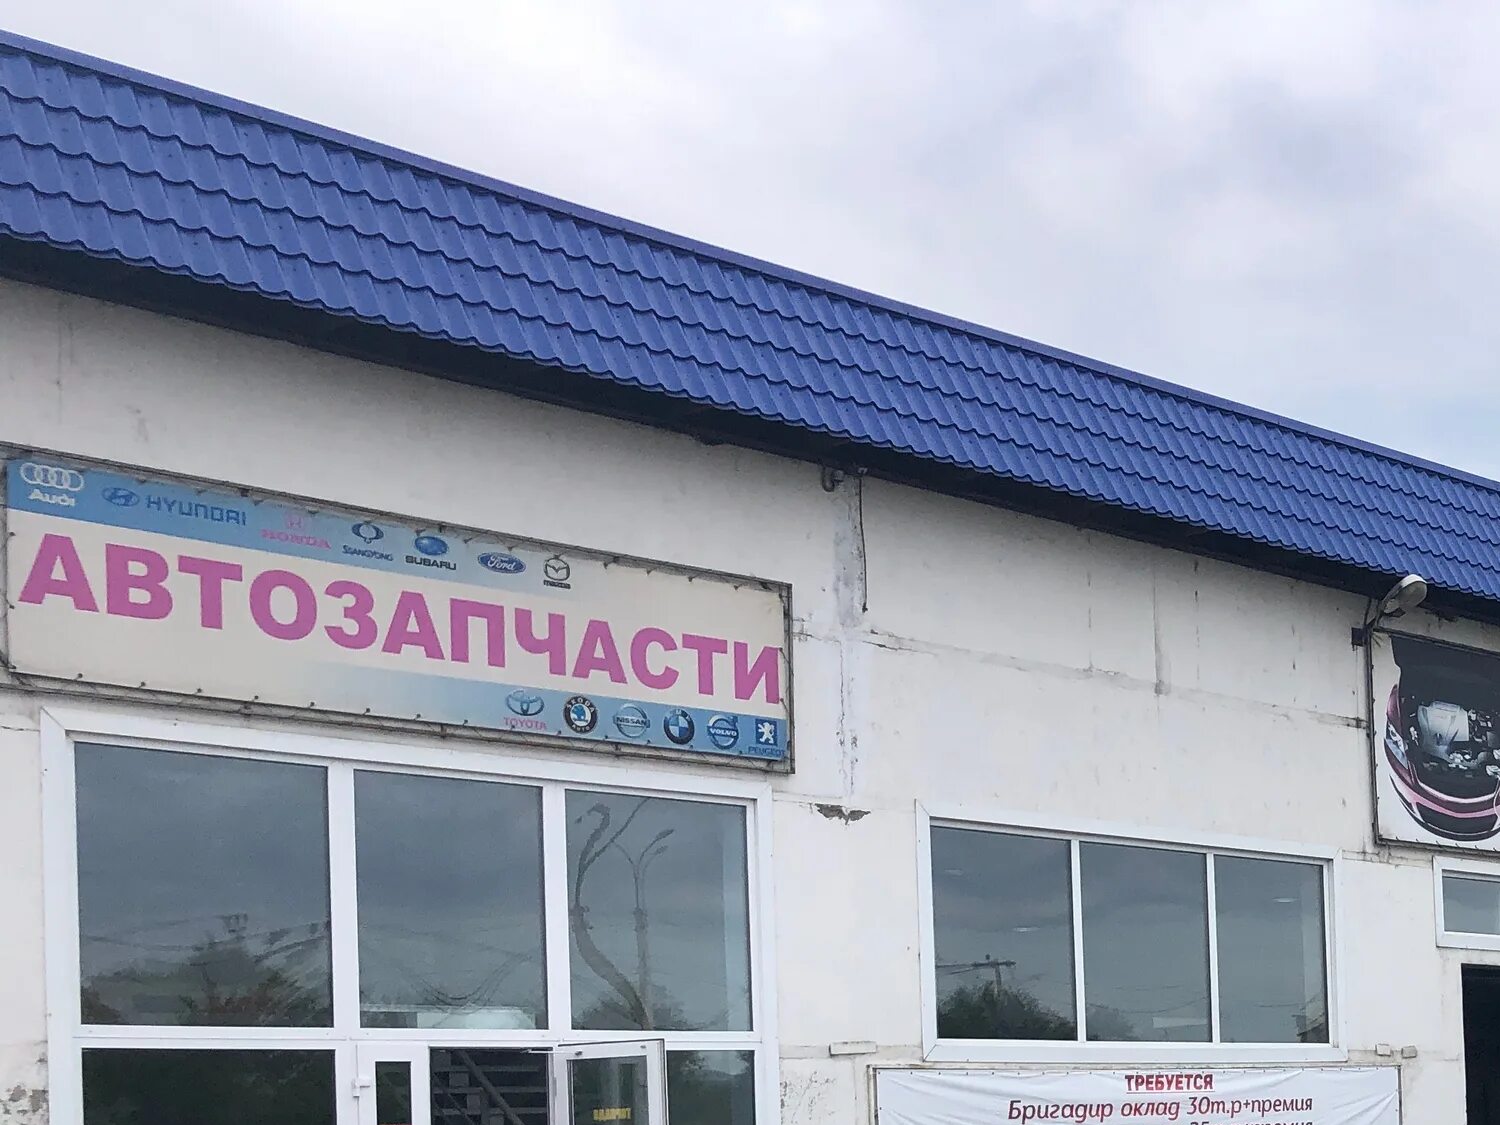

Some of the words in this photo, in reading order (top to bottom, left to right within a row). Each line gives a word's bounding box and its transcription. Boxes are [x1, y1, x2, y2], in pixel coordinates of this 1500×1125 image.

[28, 488, 77, 507] Audi
[146, 494, 247, 527] HYUNDAI
[261, 528, 332, 550] HONDA
[405, 555, 457, 571] SUBARU
[487, 553, 517, 572] Ford
[18, 533, 780, 704] АВТОЗАПЧАСТИ
[503, 716, 547, 731] TOYOTA
[616, 716, 649, 727] NISSAN
[709, 727, 737, 737] VOLVO
[748, 745, 785, 756] PEUGEOT
[1124, 1074, 1214, 1091] ТРЕБУЕТСЯ
[1008, 1100, 1114, 1125] Бригадир
[1120, 1101, 1180, 1121] оклад
[1186, 1096, 1313, 1118] 30т.р+премия
